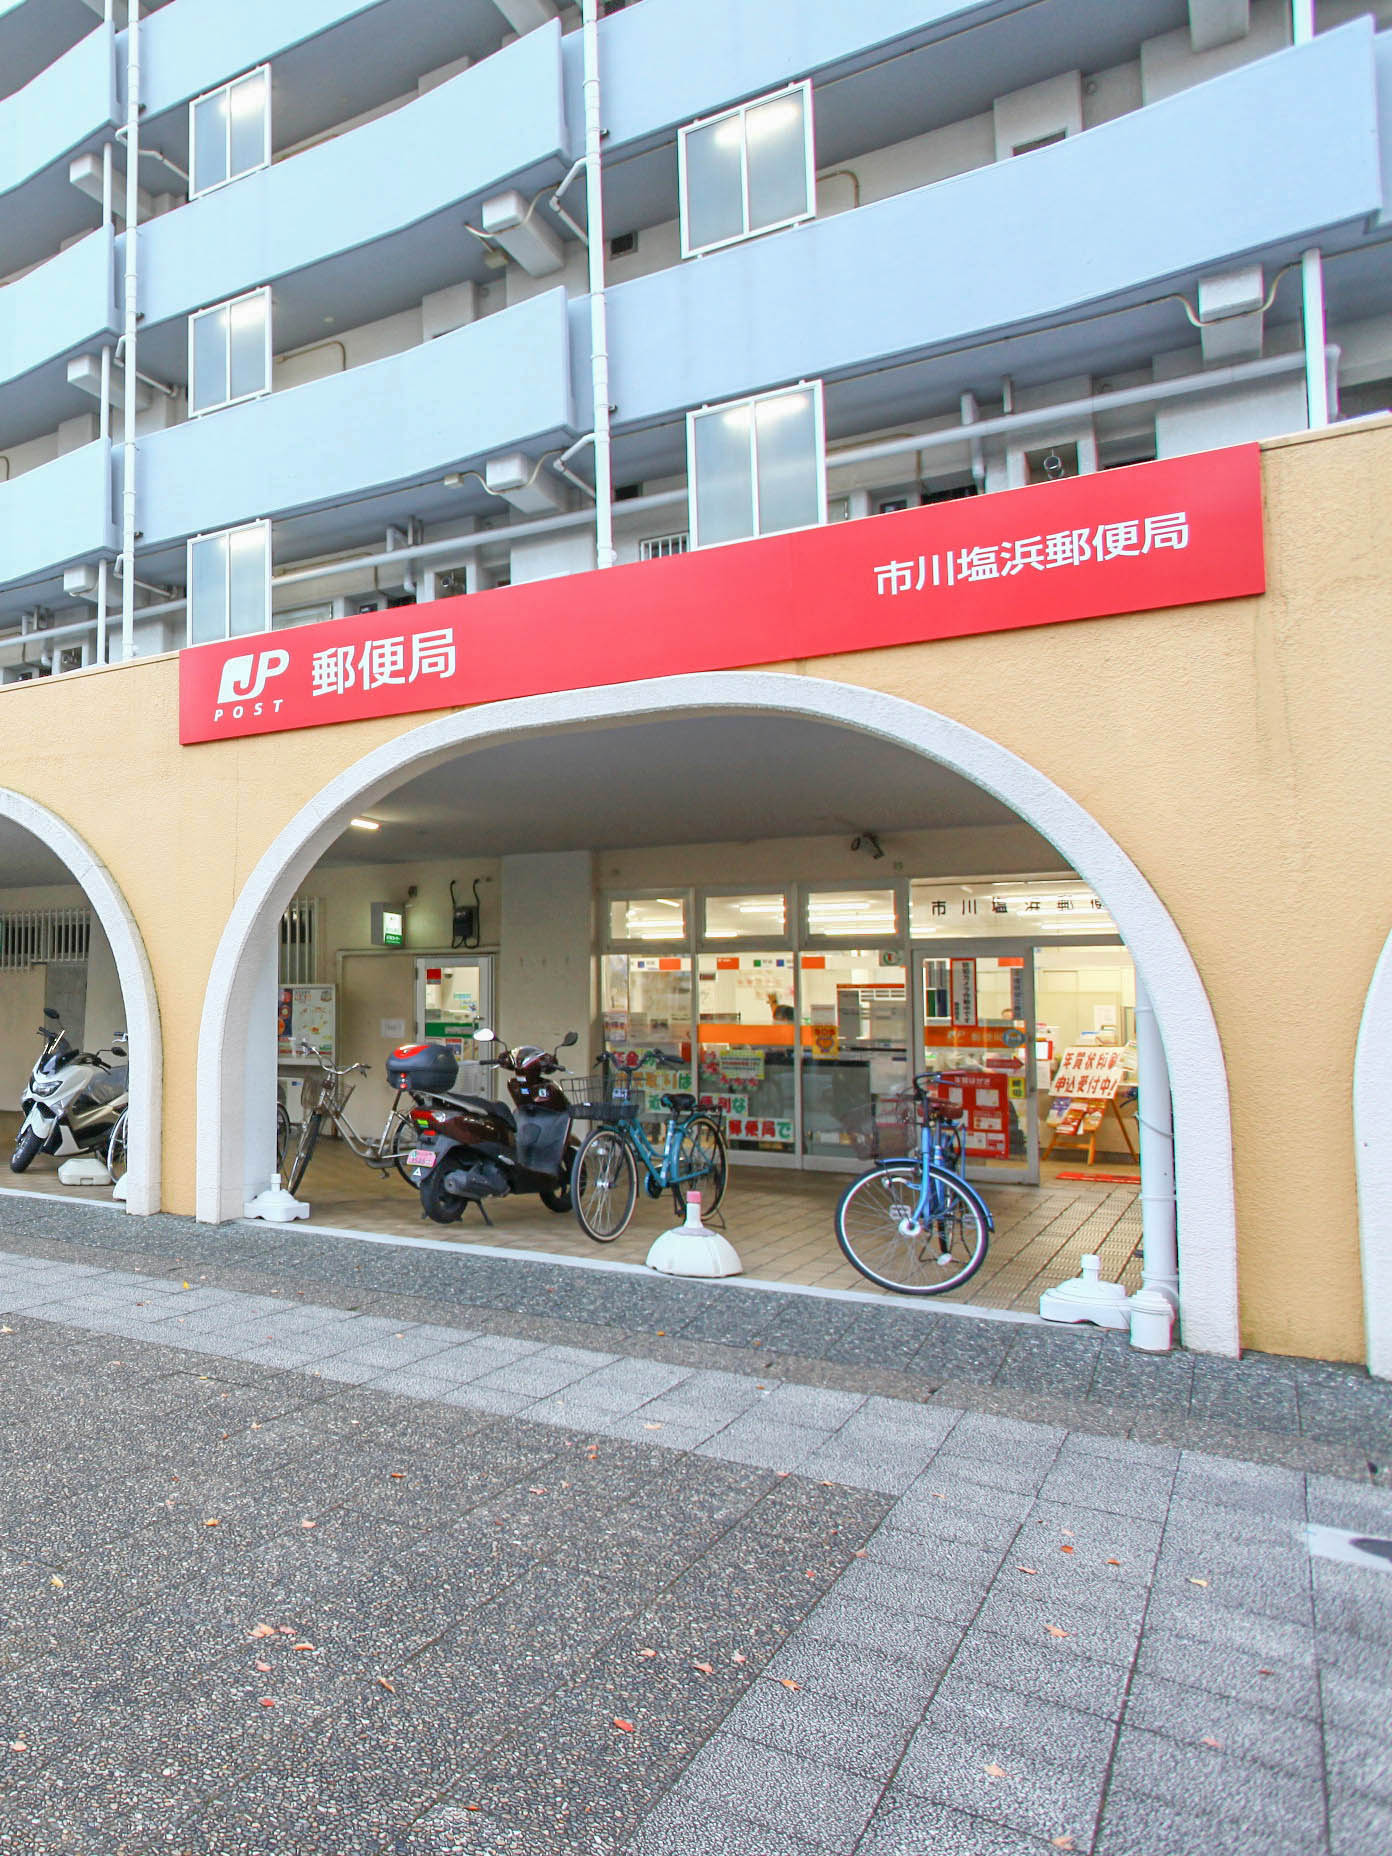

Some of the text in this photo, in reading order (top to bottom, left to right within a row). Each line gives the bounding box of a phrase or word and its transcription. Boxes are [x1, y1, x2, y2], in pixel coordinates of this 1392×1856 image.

[873, 511, 1190, 596] 市川塩浜郵便局
[311, 628, 456, 697] 郵便局
[213, 699, 284, 722] POST
[728, 1118, 793, 1139] 郵便局で
